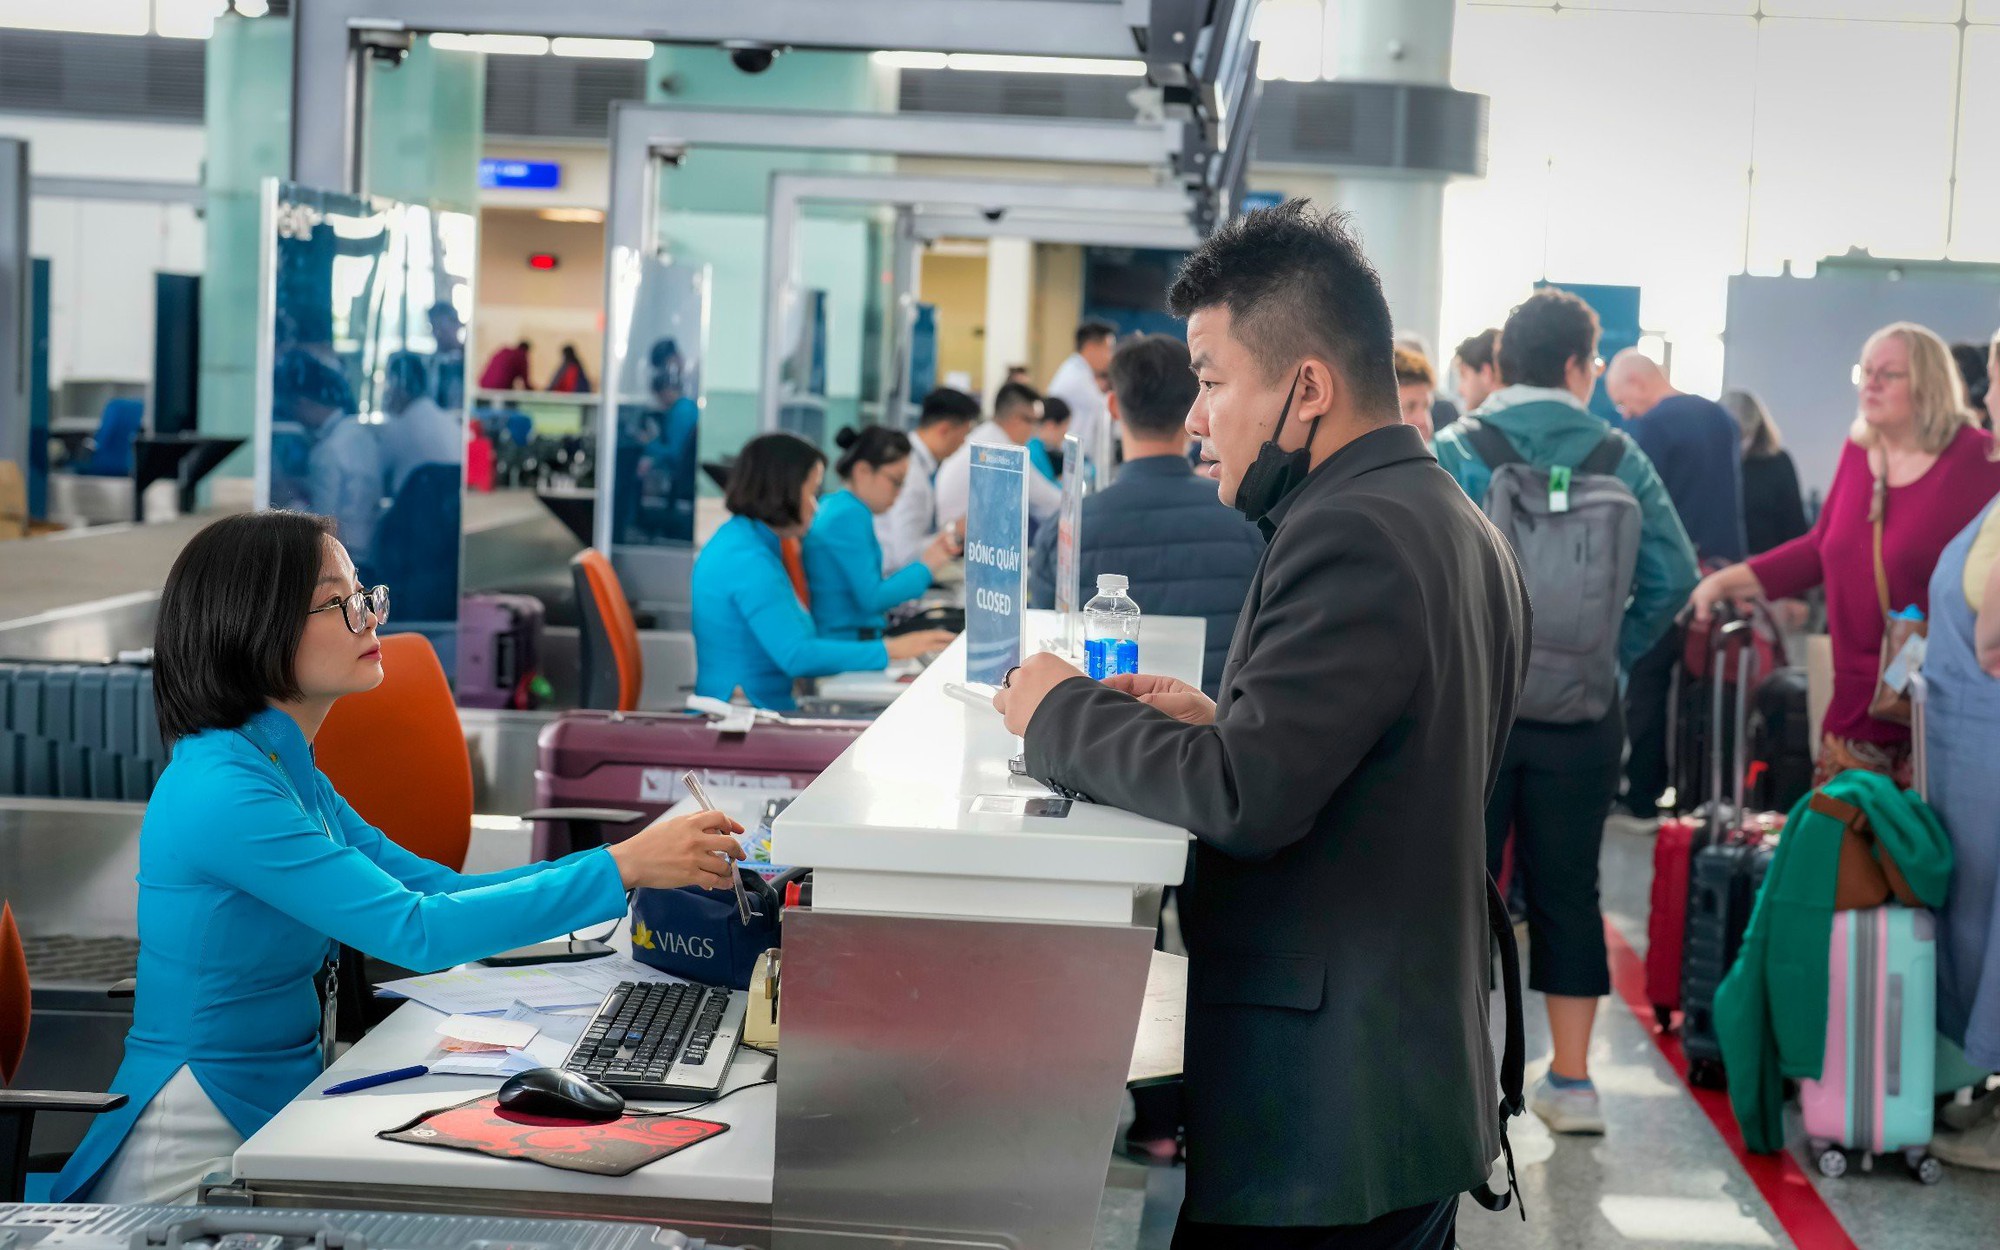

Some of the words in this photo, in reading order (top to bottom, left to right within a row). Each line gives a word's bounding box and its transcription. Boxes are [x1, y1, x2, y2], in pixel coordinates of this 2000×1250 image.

[968, 540, 995, 566] ĐÓNG
[976, 587, 1011, 616] CLOSED
[656, 930, 715, 958] VIAGS
